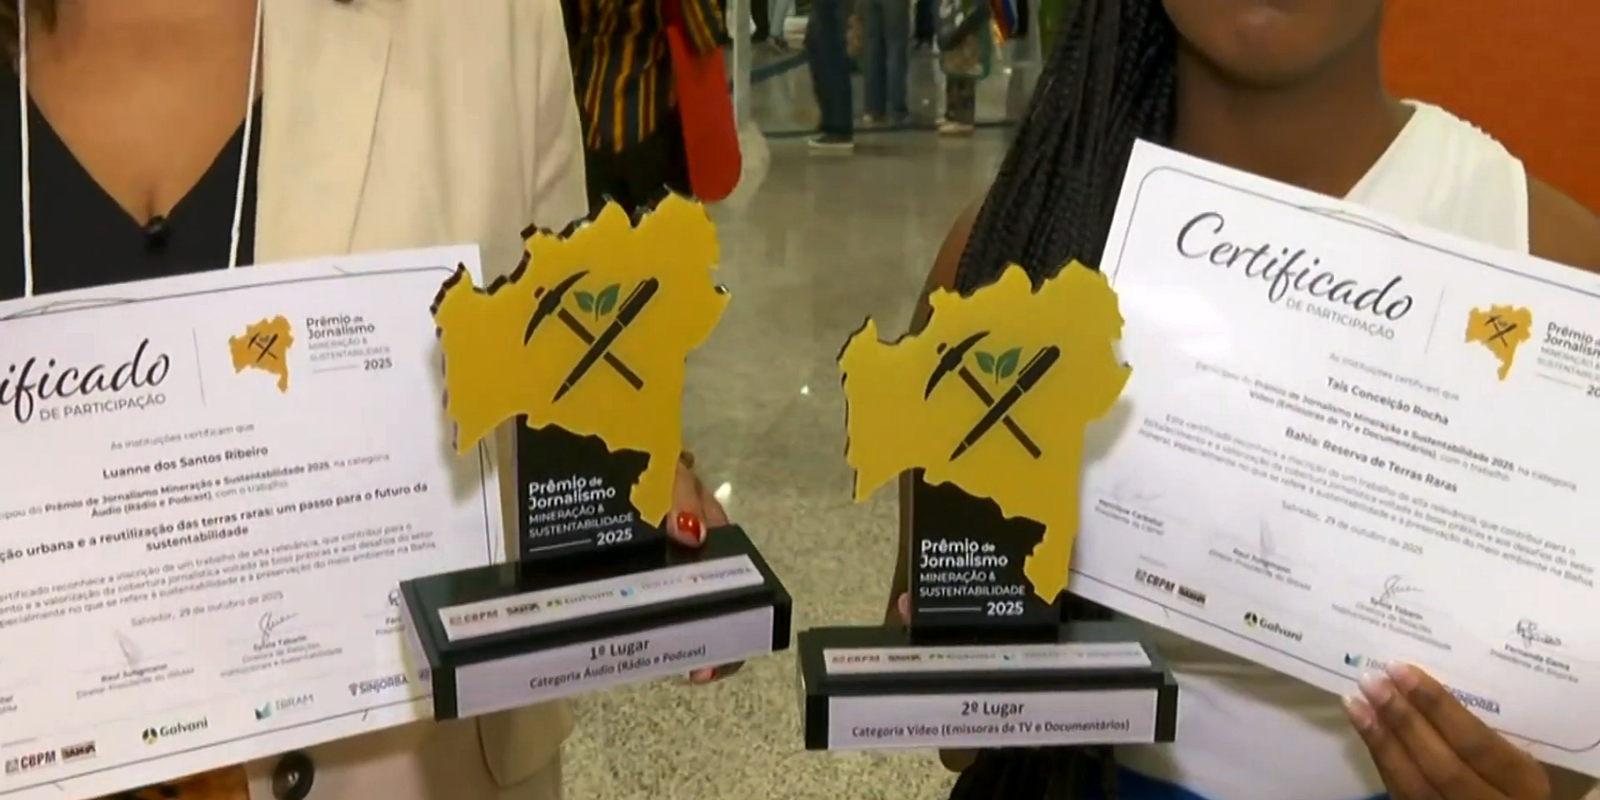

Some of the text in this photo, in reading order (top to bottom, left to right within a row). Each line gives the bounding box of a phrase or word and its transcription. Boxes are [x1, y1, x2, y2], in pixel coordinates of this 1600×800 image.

[1177, 211, 1413, 322] Certificado
[306, 314, 351, 327] Prêmio
[1286, 298, 1396, 341] DE PARTICIPAÇÃO
[308, 323, 375, 340] Jornalismo
[1547, 321, 1593, 344] Prêmio
[364, 357, 393, 371] 2025
[39, 393, 166, 422] DE PARTICIPAÇÃO
[1350, 385, 1409, 412] Conceição
[1412, 404, 1448, 425] Rocha
[102, 446, 268, 479] Luanne dos Santos Ribeiro
[1322, 439, 1367, 463] Reserva
[1370, 456, 1385, 468] de
[1388, 460, 1422, 481] Terras
[1425, 473, 1457, 493] Raras
[528, 475, 603, 496] Prêmio de
[528, 487, 616, 510] Jornalismo
[26, 540, 74, 556] urbana
[78, 538, 85, 547] e
[89, 537, 96, 545] a
[99, 523, 173, 543] reutilização
[176, 519, 198, 531] das
[201, 513, 236, 527] terras
[240, 507, 273, 520] raras:
[276, 503, 296, 514] um
[299, 497, 332, 513] passo
[336, 493, 361, 506] para
[364, 491, 372, 500] o
[374, 486, 410, 499] futuro
[413, 482, 427, 492] da
[529, 505, 595, 524] MINERAÇÃO
[529, 512, 634, 538] SUSTENTABILIDADE
[146, 525, 248, 551] sustentabilidade
[596, 528, 633, 546] 2025
[921, 537, 996, 554] Prêmio de
[920, 553, 1008, 569] Jornalismo
[920, 569, 987, 583] MINERAÇÃO
[919, 584, 1025, 598] SUSTENTABILIDADE
[986, 601, 1024, 616] 2025
[1259, 617, 1302, 643] Galvani
[610, 639, 650, 658] Lugar
[529, 672, 581, 689] Categoria
[617, 655, 651, 674] (Rádio
[663, 644, 706, 663] Podcast)
[359, 674, 409, 695] SINJORBA
[961, 701, 1025, 718] 2º Lugar
[159, 716, 208, 738] Galvani
[852, 719, 1130, 739] Categoria Vídeo (Emissoras de TV e Documentários)
[20, 749, 56, 769] CBPM
